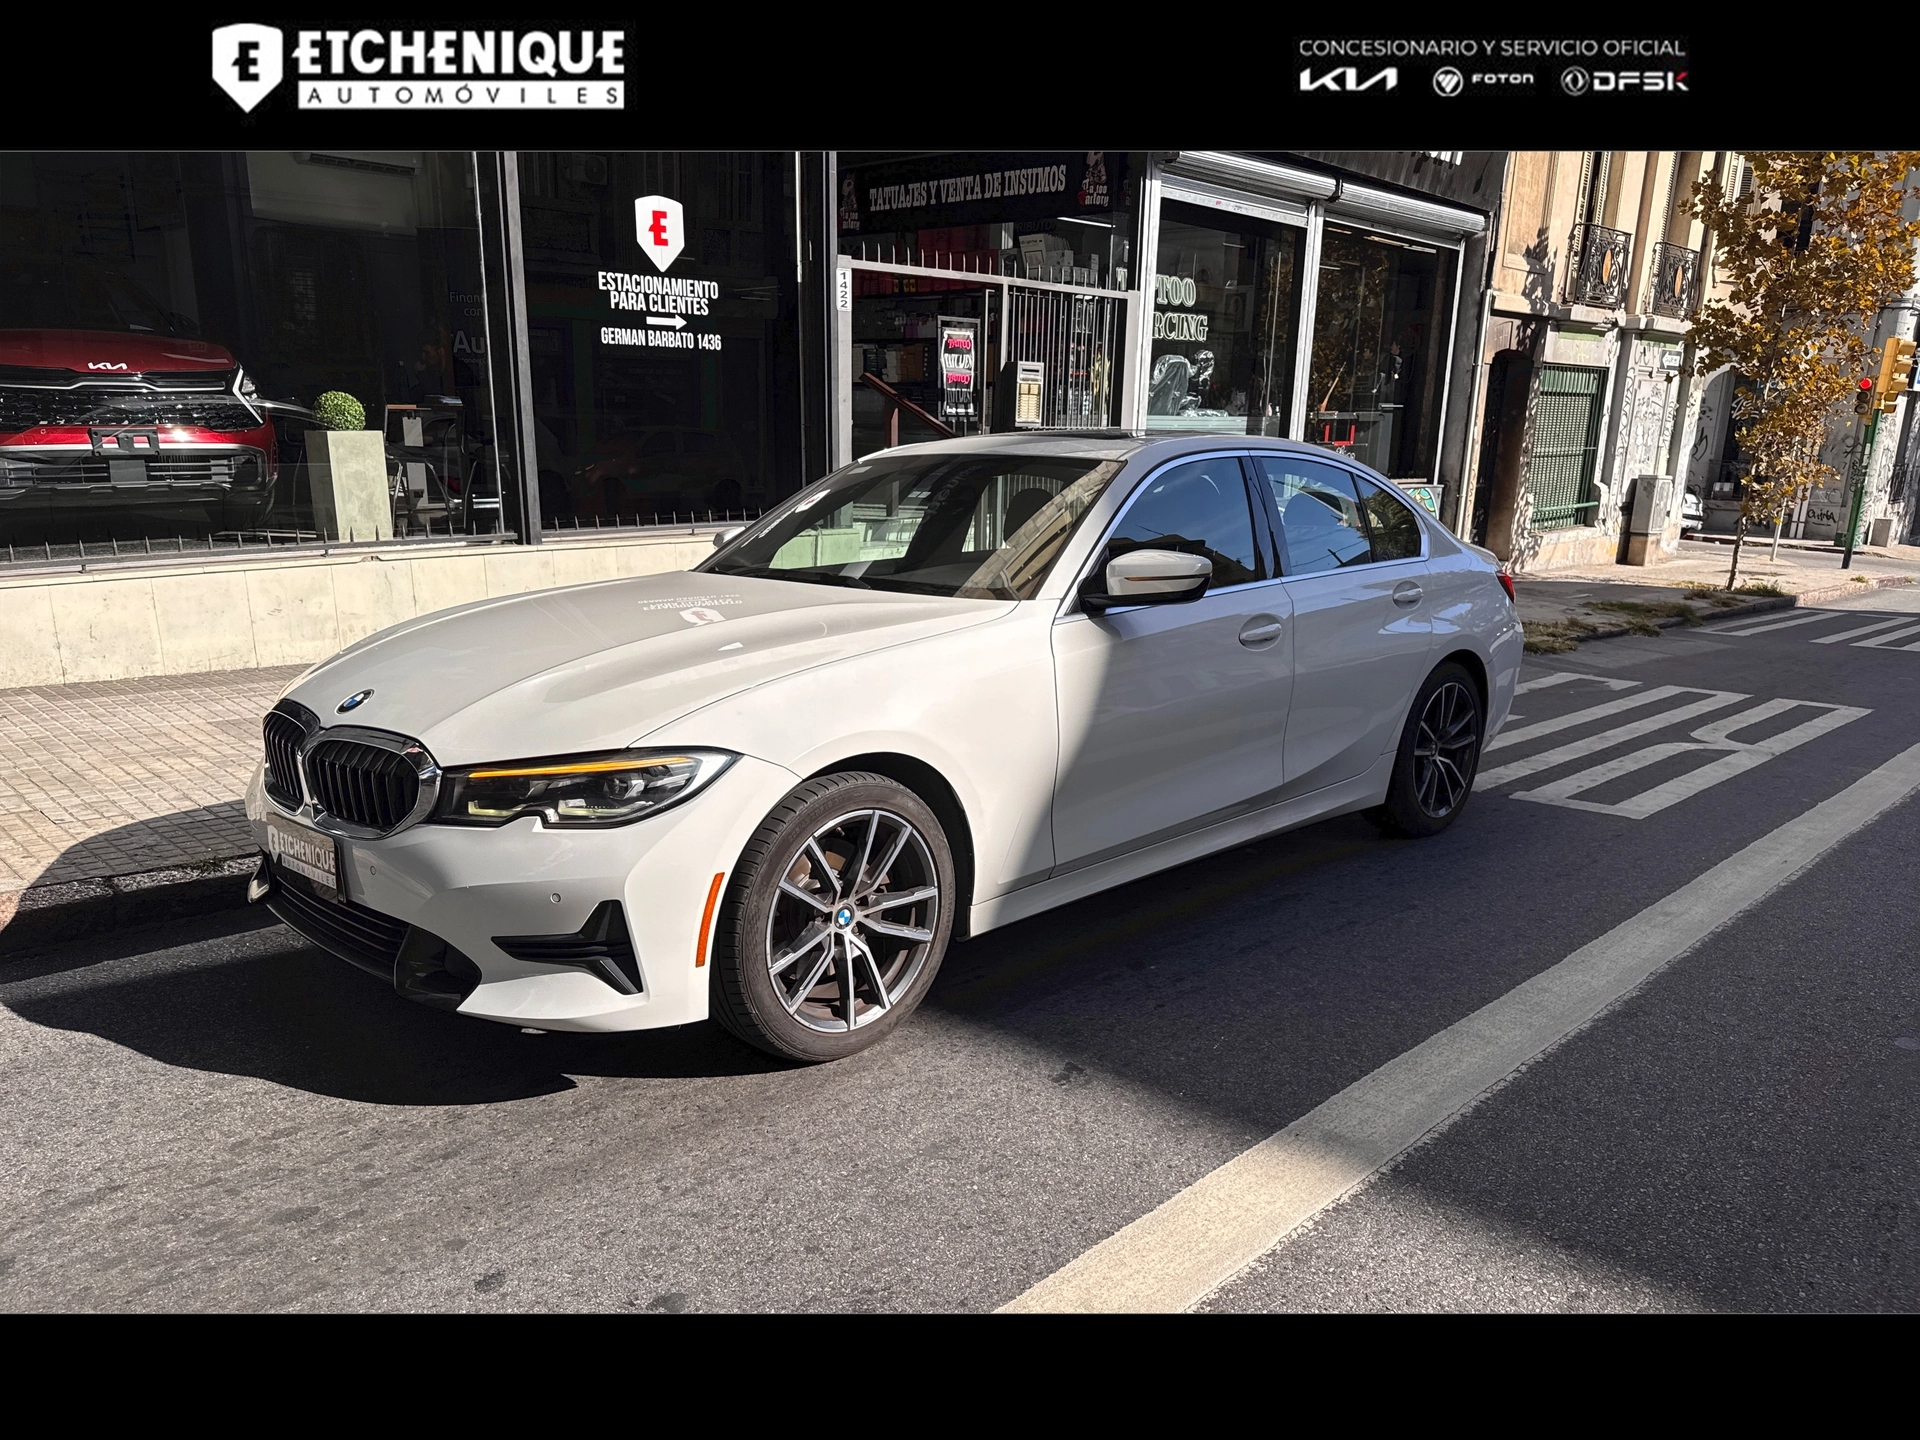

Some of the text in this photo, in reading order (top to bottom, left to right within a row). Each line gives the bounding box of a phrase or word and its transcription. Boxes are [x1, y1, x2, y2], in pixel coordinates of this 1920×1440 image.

[869, 164, 1067, 211] TATUAJES Y VENTA DE INSUMOS
[449, 292, 485, 303] Finan
[598, 271, 719, 300] ESTACIONAMIENTO
[839, 271, 848, 308] 1422
[610, 290, 709, 316] PARA CLIENTES
[600, 327, 722, 351] GERMAN BARBATO 1436
[88, 362, 128, 370] KIA
[279, 831, 336, 873] ETCHENIQUE
